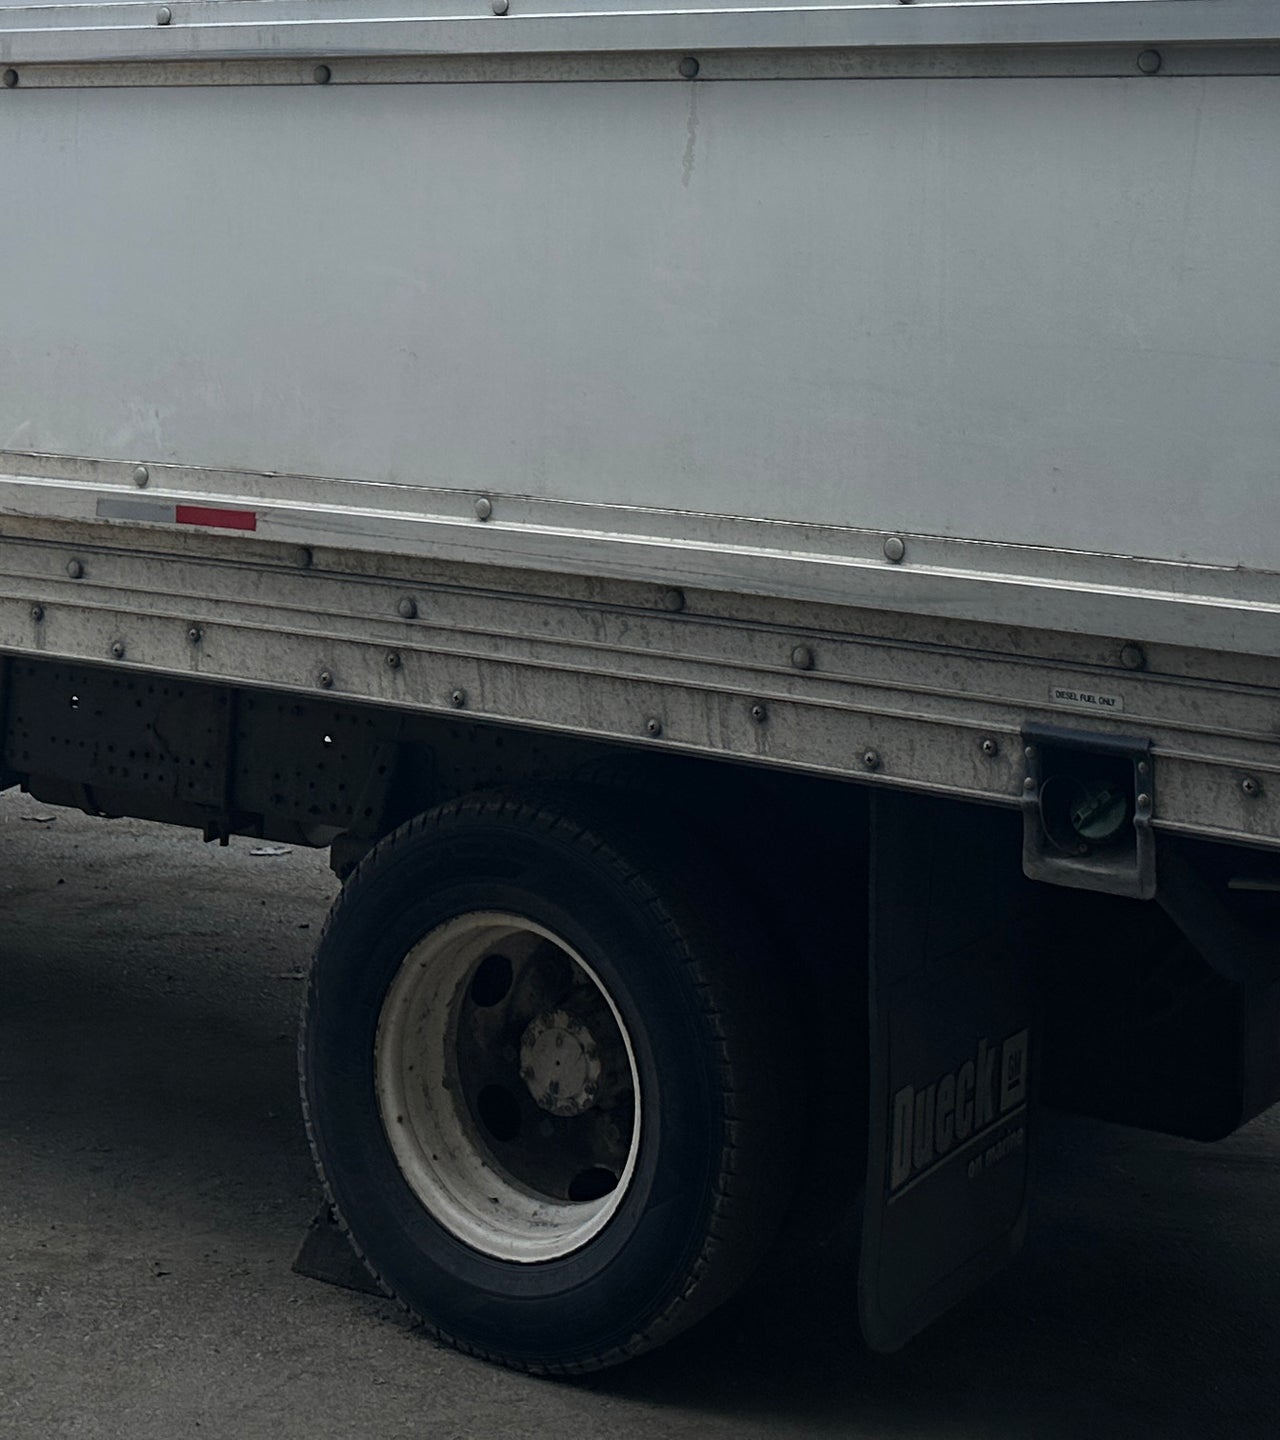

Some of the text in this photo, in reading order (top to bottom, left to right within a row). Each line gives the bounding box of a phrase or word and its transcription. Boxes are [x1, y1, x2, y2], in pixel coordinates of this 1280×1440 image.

[1055, 690, 1116, 707] DIESEL FUEL ONLY
